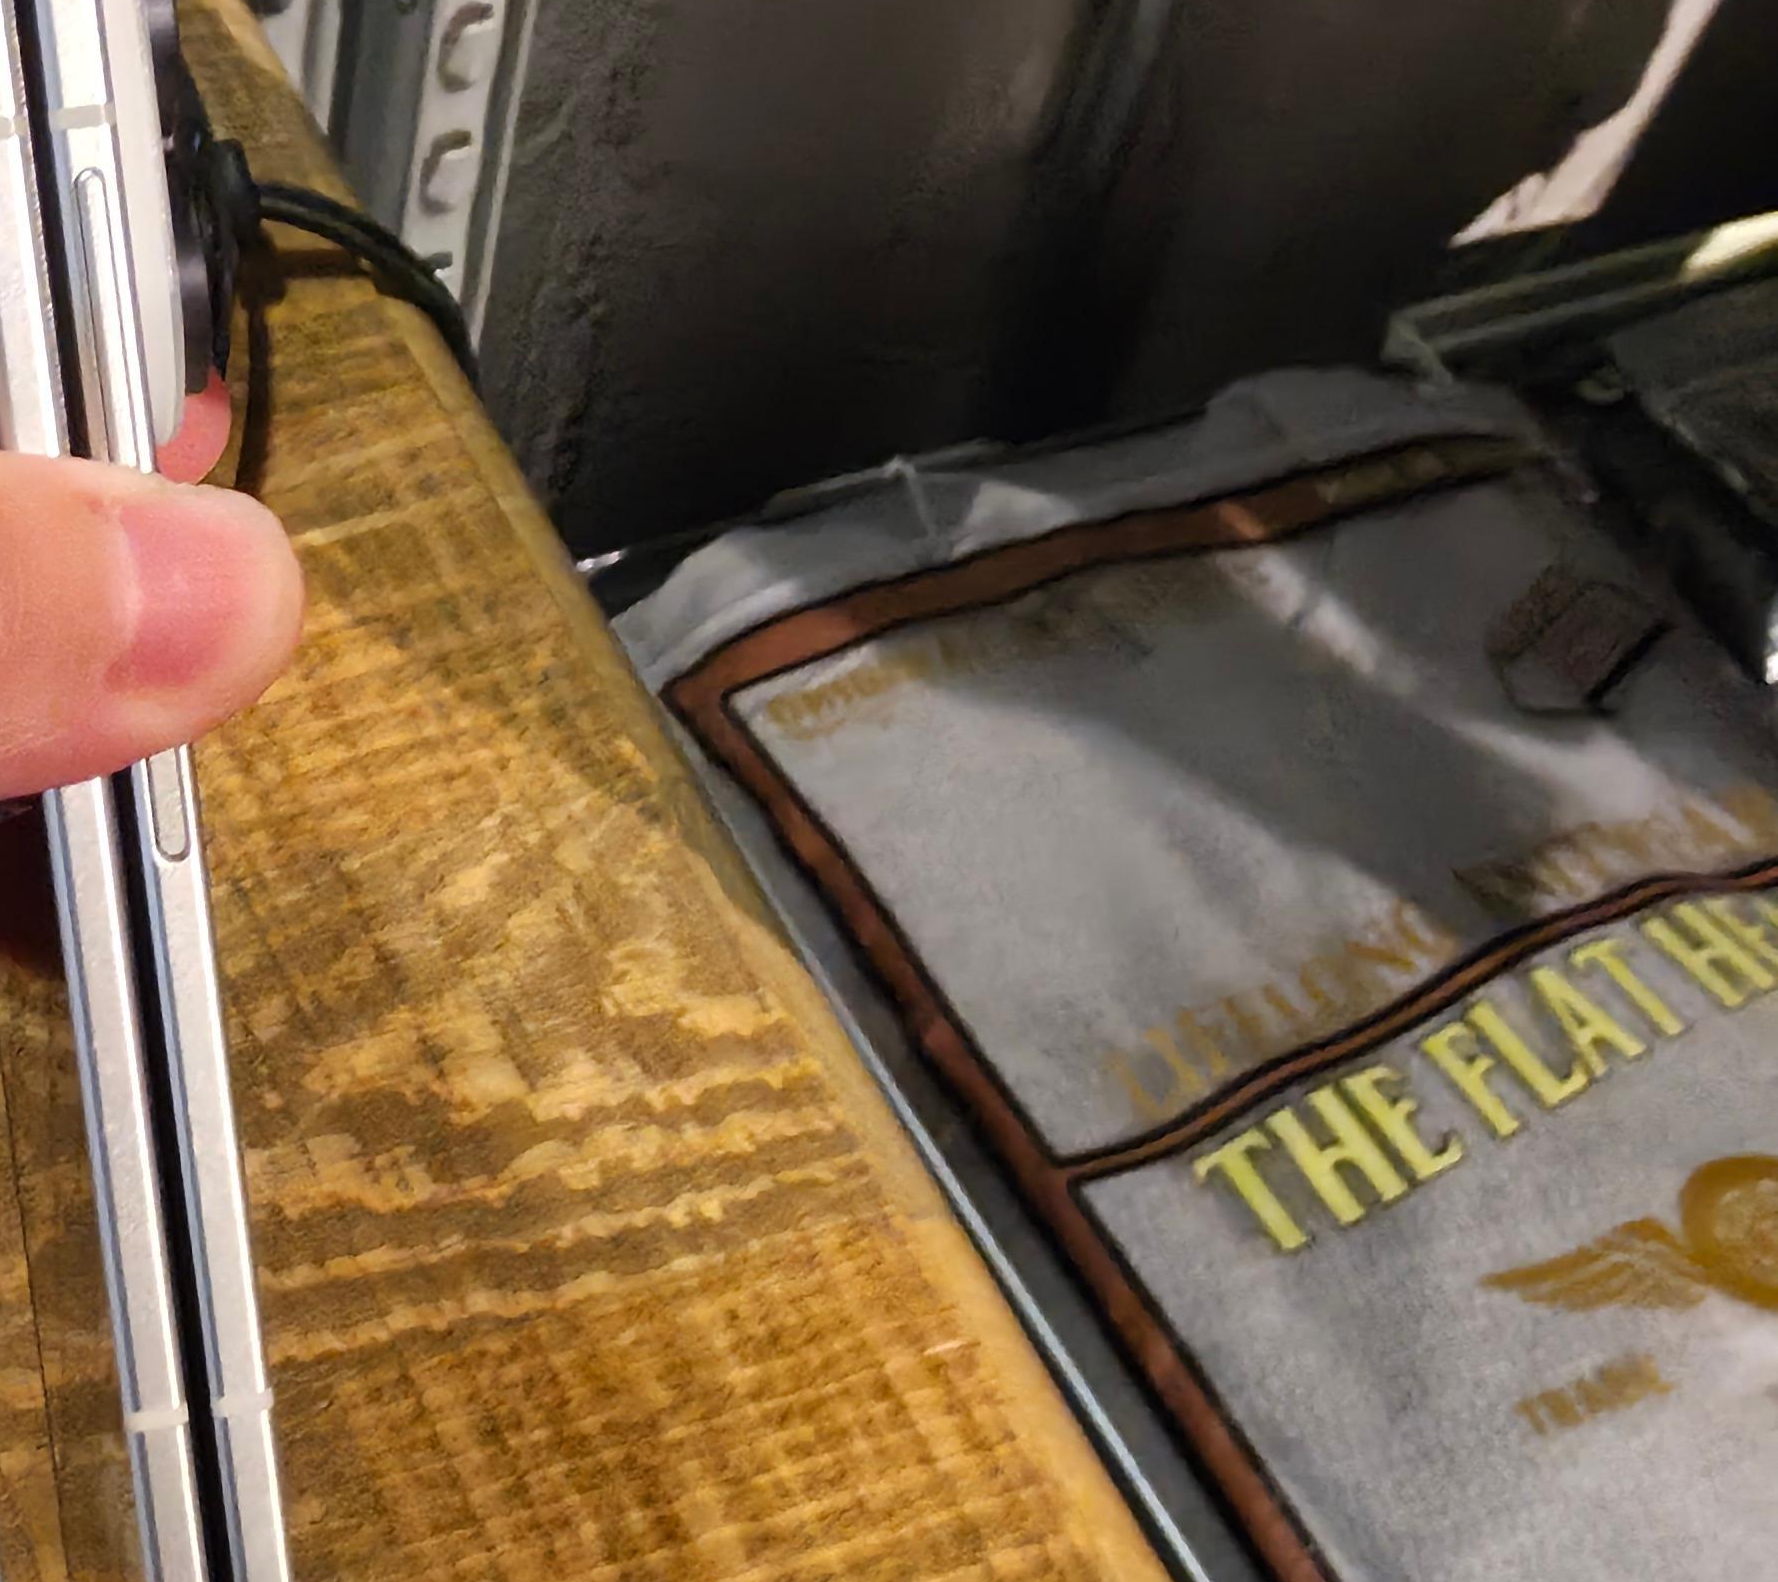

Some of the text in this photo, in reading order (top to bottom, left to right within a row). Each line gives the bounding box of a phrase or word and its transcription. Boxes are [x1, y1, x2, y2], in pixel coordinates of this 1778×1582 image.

[1192, 896, 1778, 1251] THE FLAT HE
